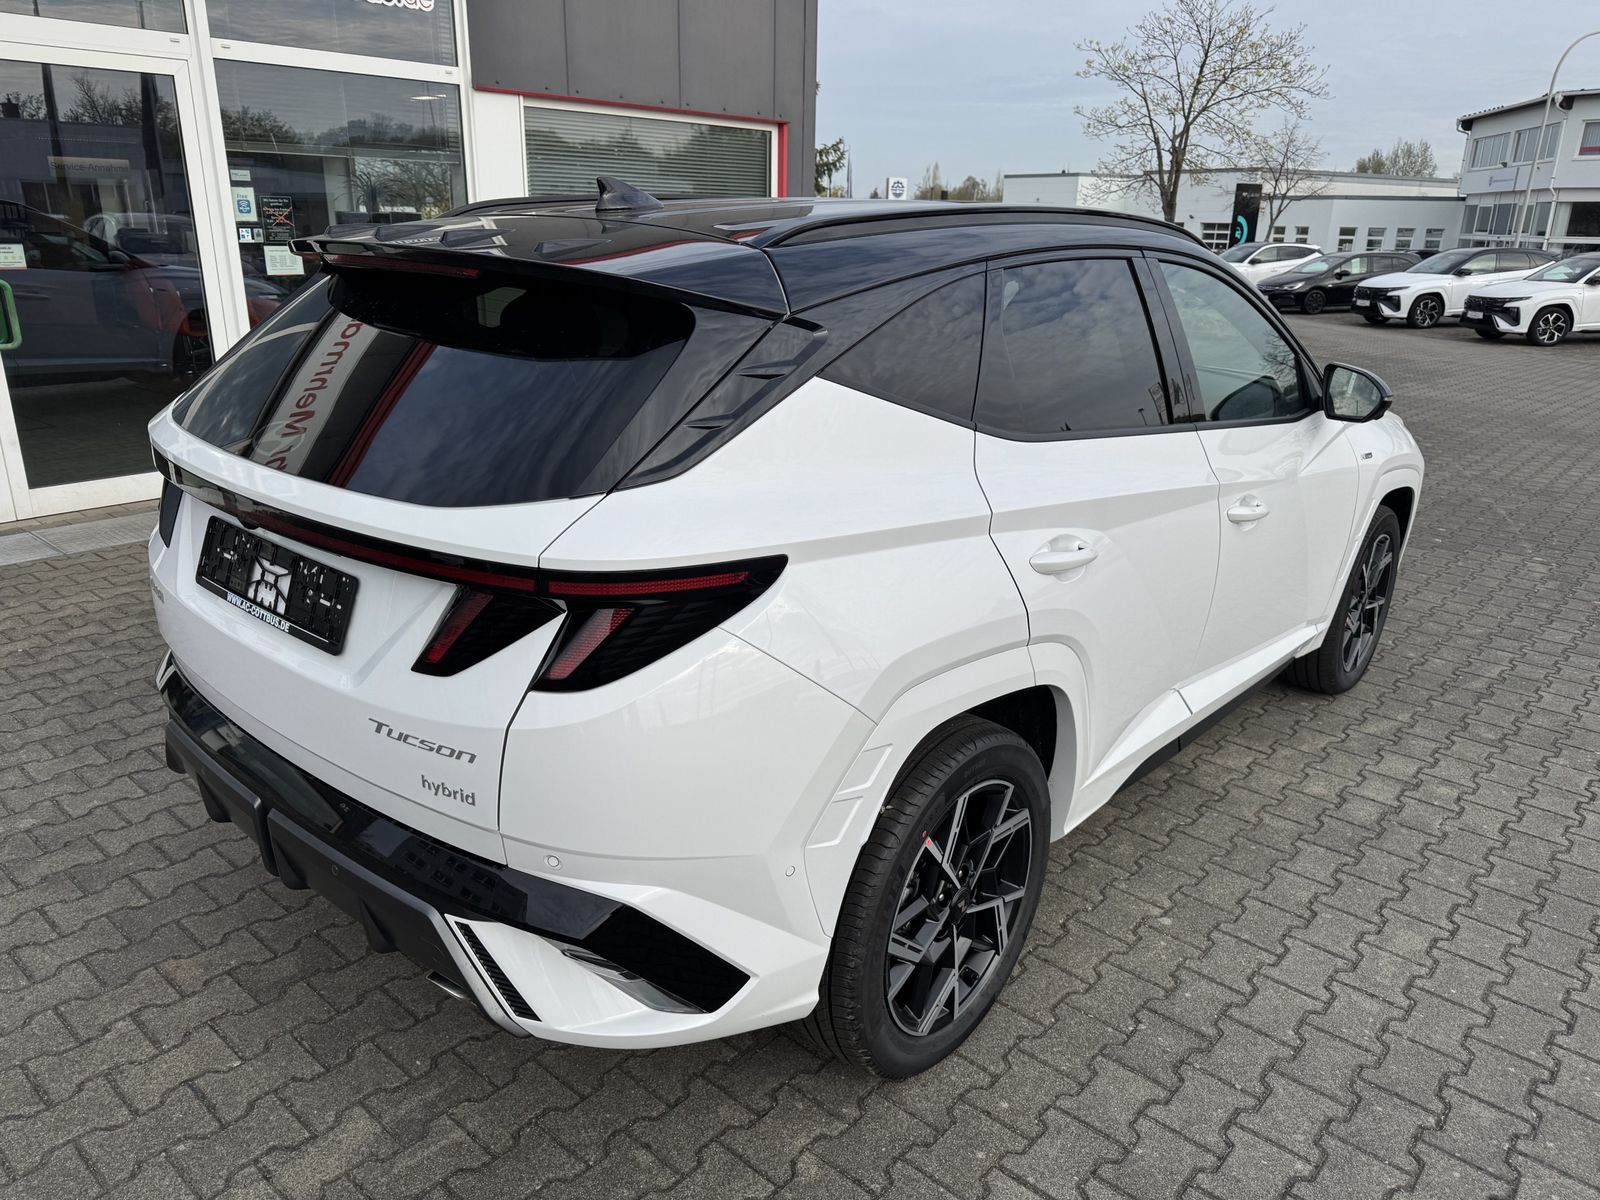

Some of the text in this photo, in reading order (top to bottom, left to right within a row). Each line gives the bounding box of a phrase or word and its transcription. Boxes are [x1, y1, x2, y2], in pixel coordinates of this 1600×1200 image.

[226, 591, 290, 633] WWW.AC-COTTBUS.DE
[368, 717, 477, 764] Tucson
[421, 774, 476, 806] hybrid
